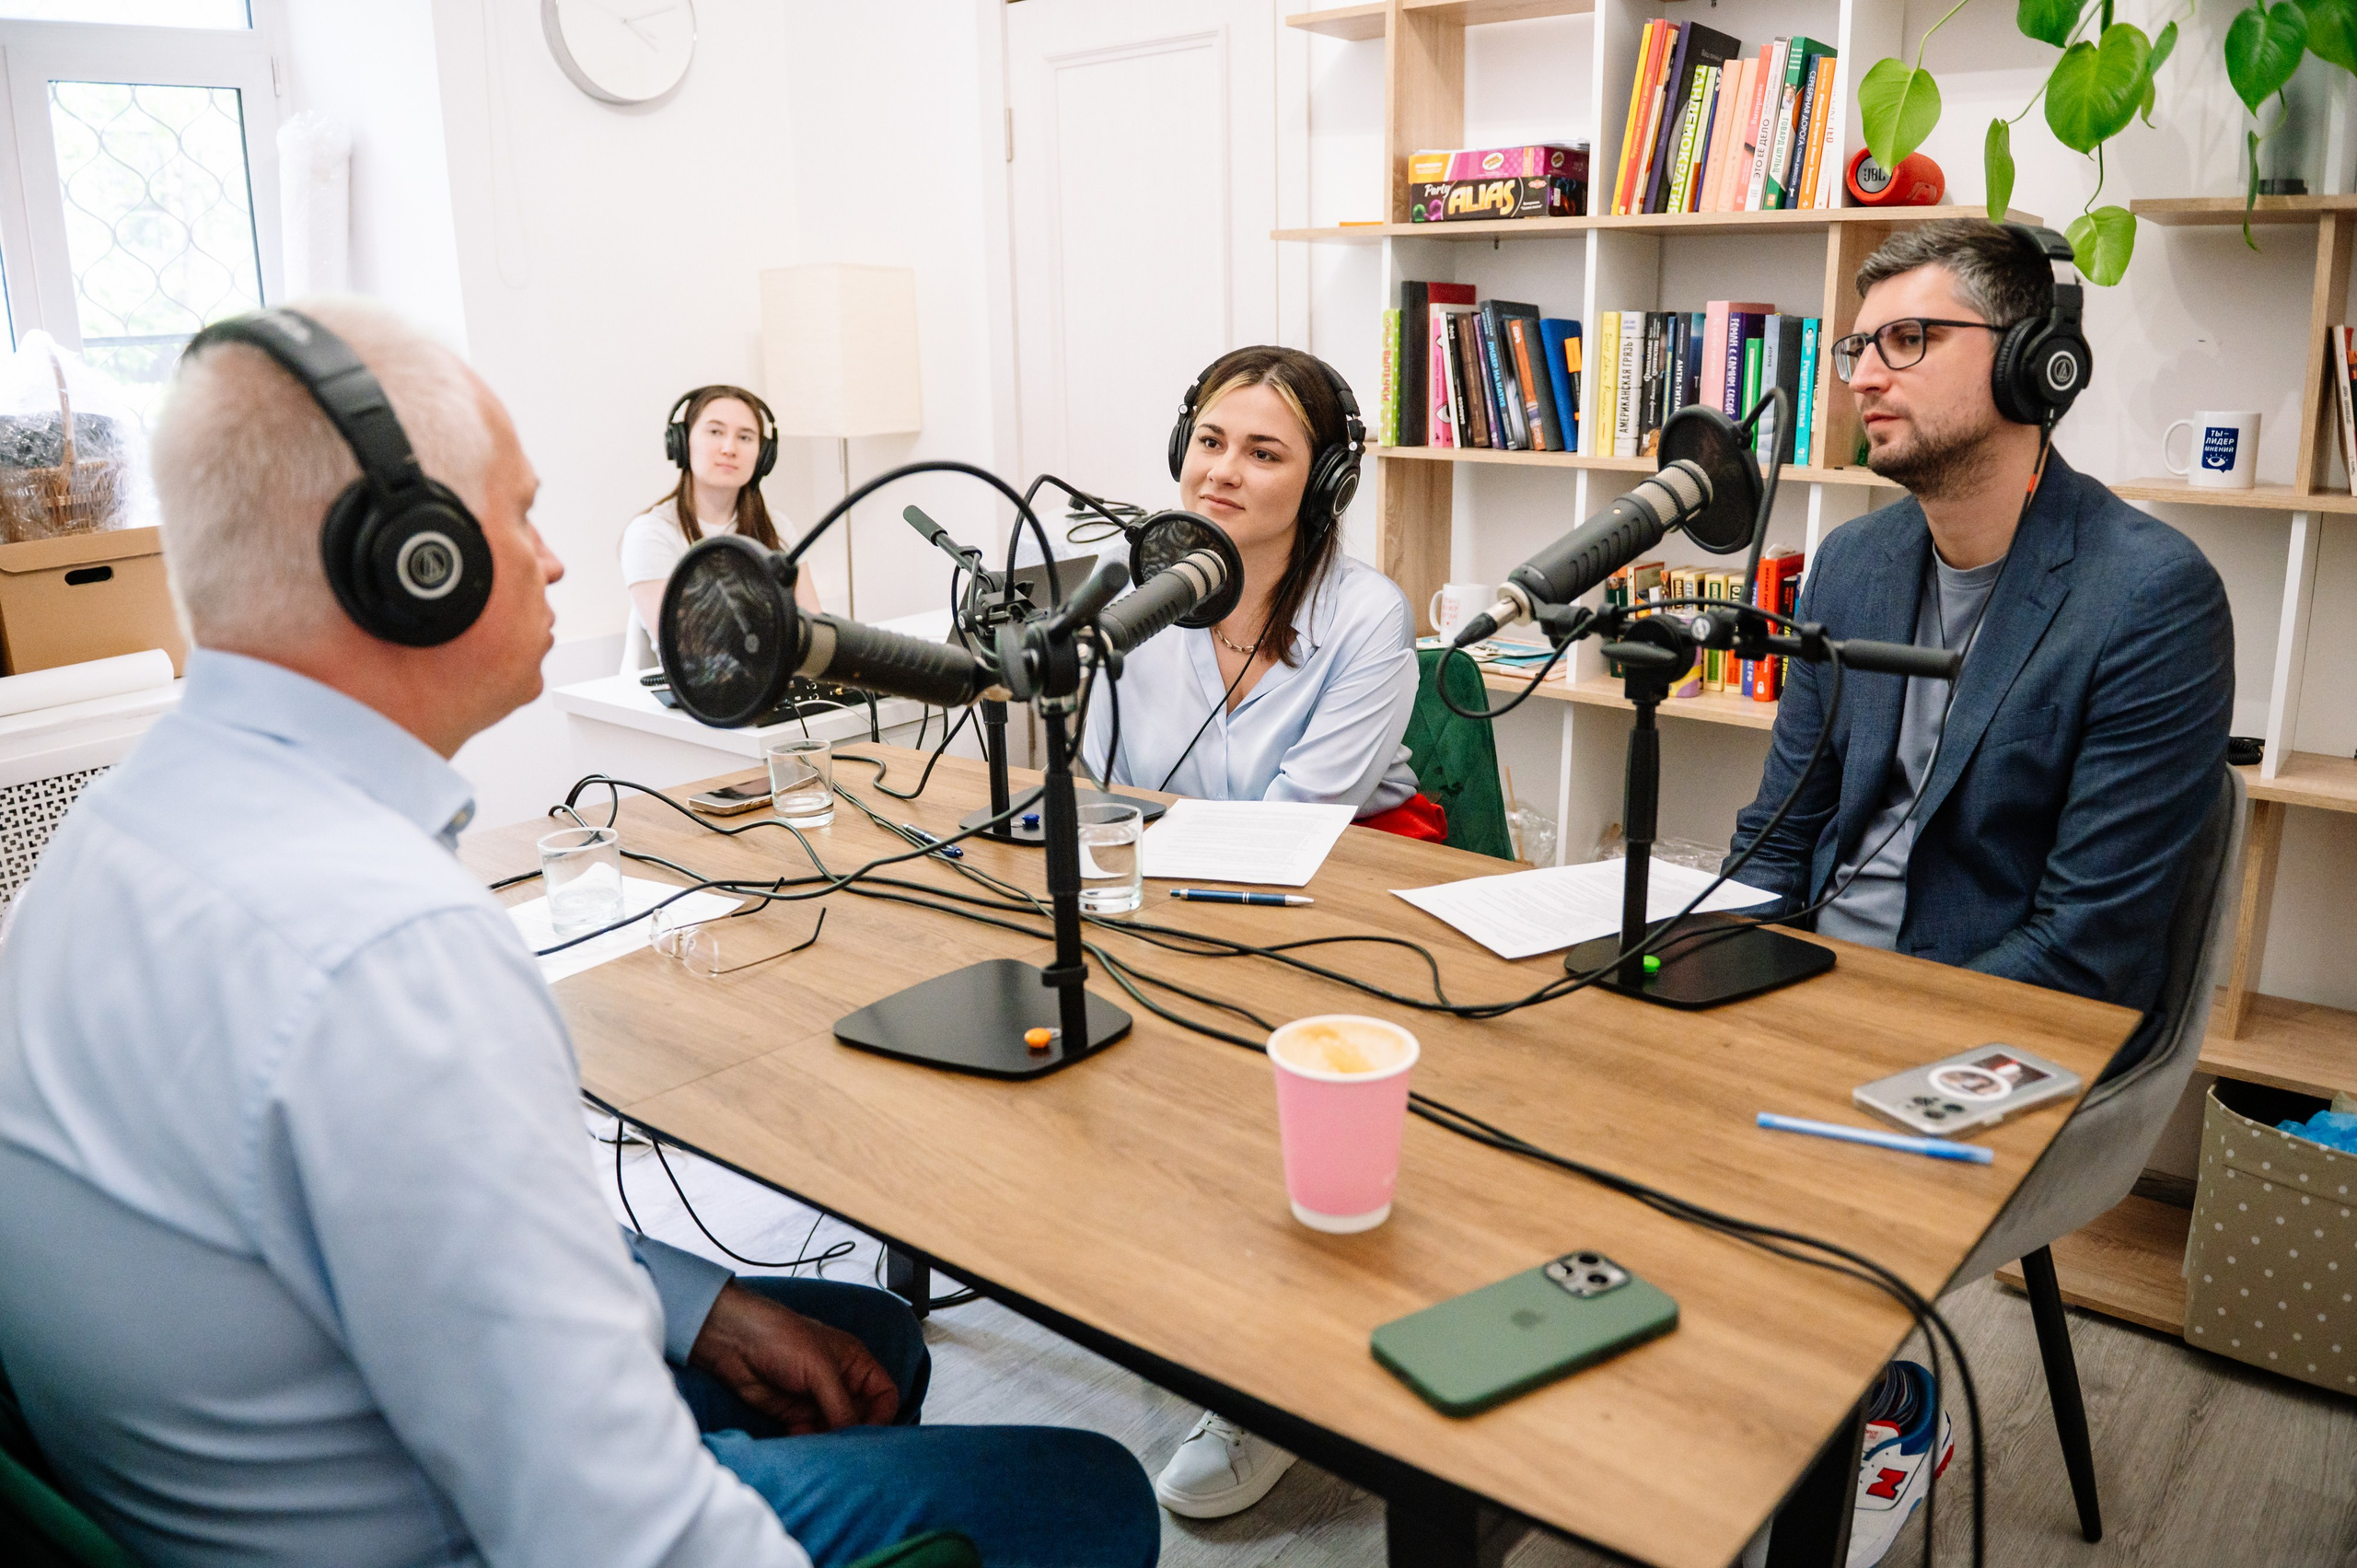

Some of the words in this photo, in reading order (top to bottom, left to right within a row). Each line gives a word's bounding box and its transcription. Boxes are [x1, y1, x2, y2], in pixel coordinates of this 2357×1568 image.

[1751, 83, 1764, 125] Выгорание
[1802, 70, 1817, 114] СЕРЕБРЯНАЯ
[1666, 65, 1703, 215] ТАНДЕМОКРАТИЯ
[1759, 118, 1771, 146] ДЕЛО
[1776, 117, 1789, 145] ГОВАРД
[1797, 115, 1808, 145] ДОРОГА
[1811, 122, 1822, 145] Встреча
[1757, 147, 1765, 158] ЕЁ
[1771, 146, 1783, 173] ШУЛЬЦ
[1809, 146, 1817, 165] Имеет
[1753, 159, 1763, 179] ЭТО
[1805, 167, 1816, 194] Значение
[1864, 168, 1886, 182] JBL
[1424, 183, 1450, 197] Party
[1447, 180, 1515, 215] ALIAS
[1728, 318, 1740, 347] РОМАН
[1487, 341, 1498, 369] ЛИДЕР
[1622, 342, 1633, 367] ГРЯЗЬ
[1643, 339, 1653, 382] Фамильные
[1651, 340, 1659, 377] ценности
[1382, 350, 1391, 401] ВЫПЕЧКИ
[1492, 369, 1501, 381] НА
[1726, 355, 1737, 387] САМИМ
[1800, 360, 1810, 392] Рецепт
[1495, 381, 1506, 408] КАТКЕ
[1674, 359, 1684, 413] АНТИ-ТИТАН
[1619, 370, 1632, 434] АМЕРИКАНСКАЯ
[1724, 389, 1736, 415] СОБОЙ
[1798, 392, 1808, 428] счастья
[2204, 445, 2235, 453] МНЕНИЙ
[2205, 437, 2235, 446] ЛИДЕР
